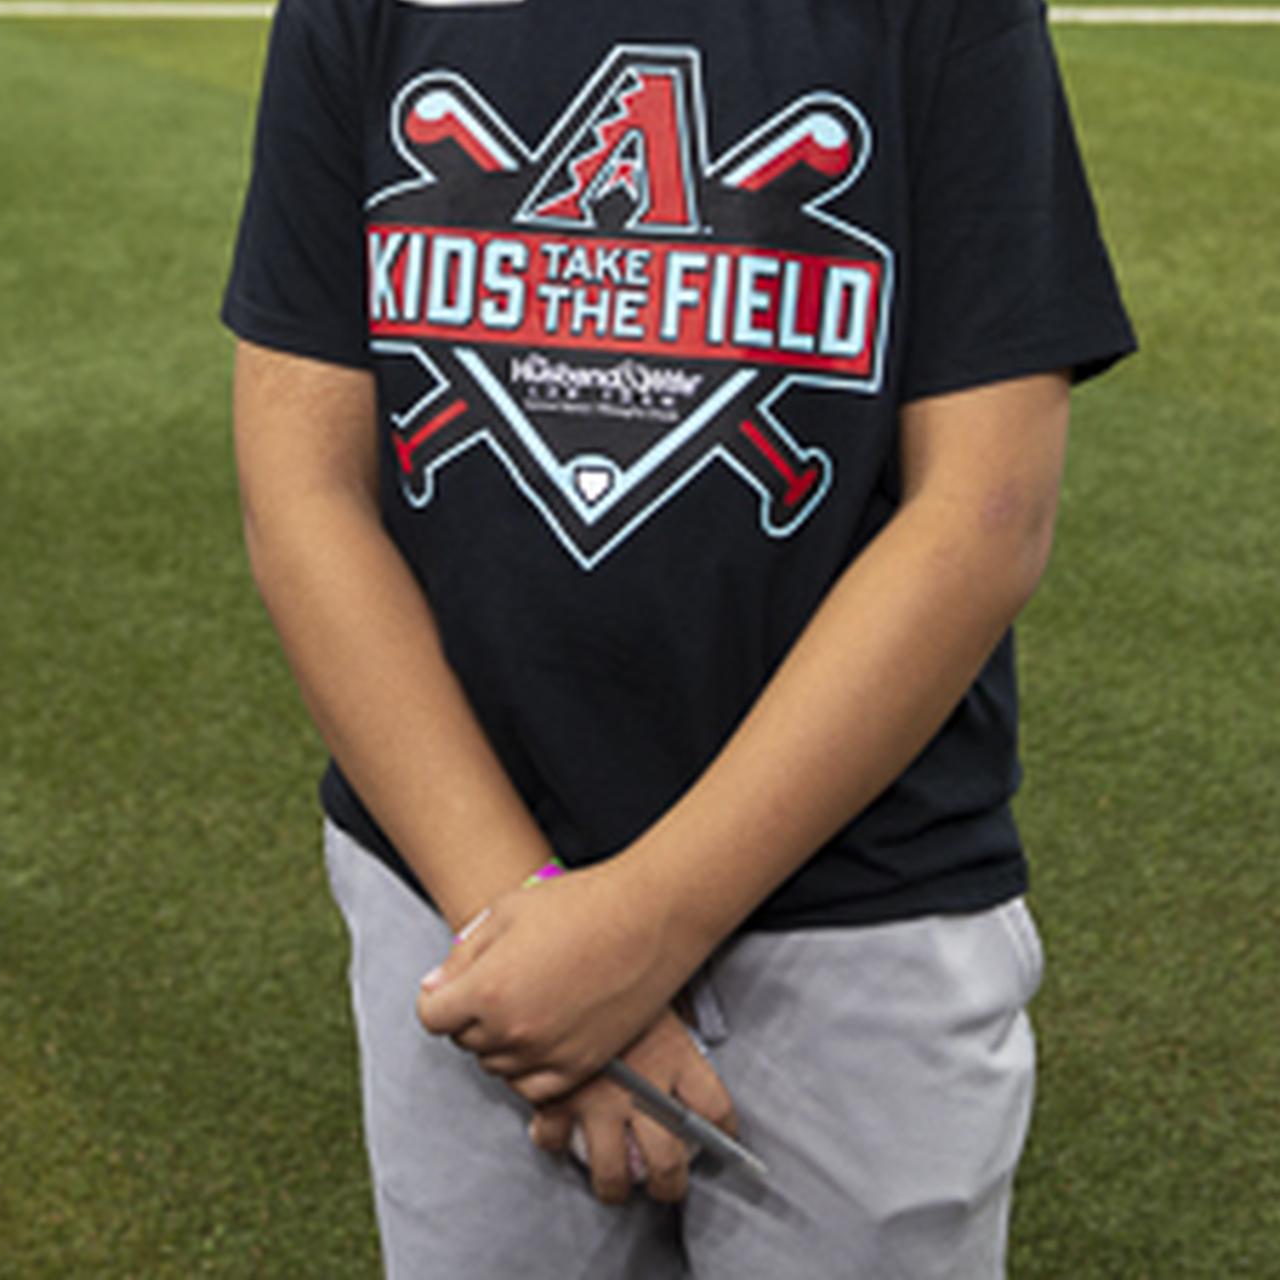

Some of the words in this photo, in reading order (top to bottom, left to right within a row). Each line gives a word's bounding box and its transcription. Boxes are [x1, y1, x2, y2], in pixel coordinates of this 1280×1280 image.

[367, 230, 529, 330] KIDS
[538, 243, 653, 286] TAKE
[657, 249, 876, 357] FIELD
[536, 284, 649, 340] THE
